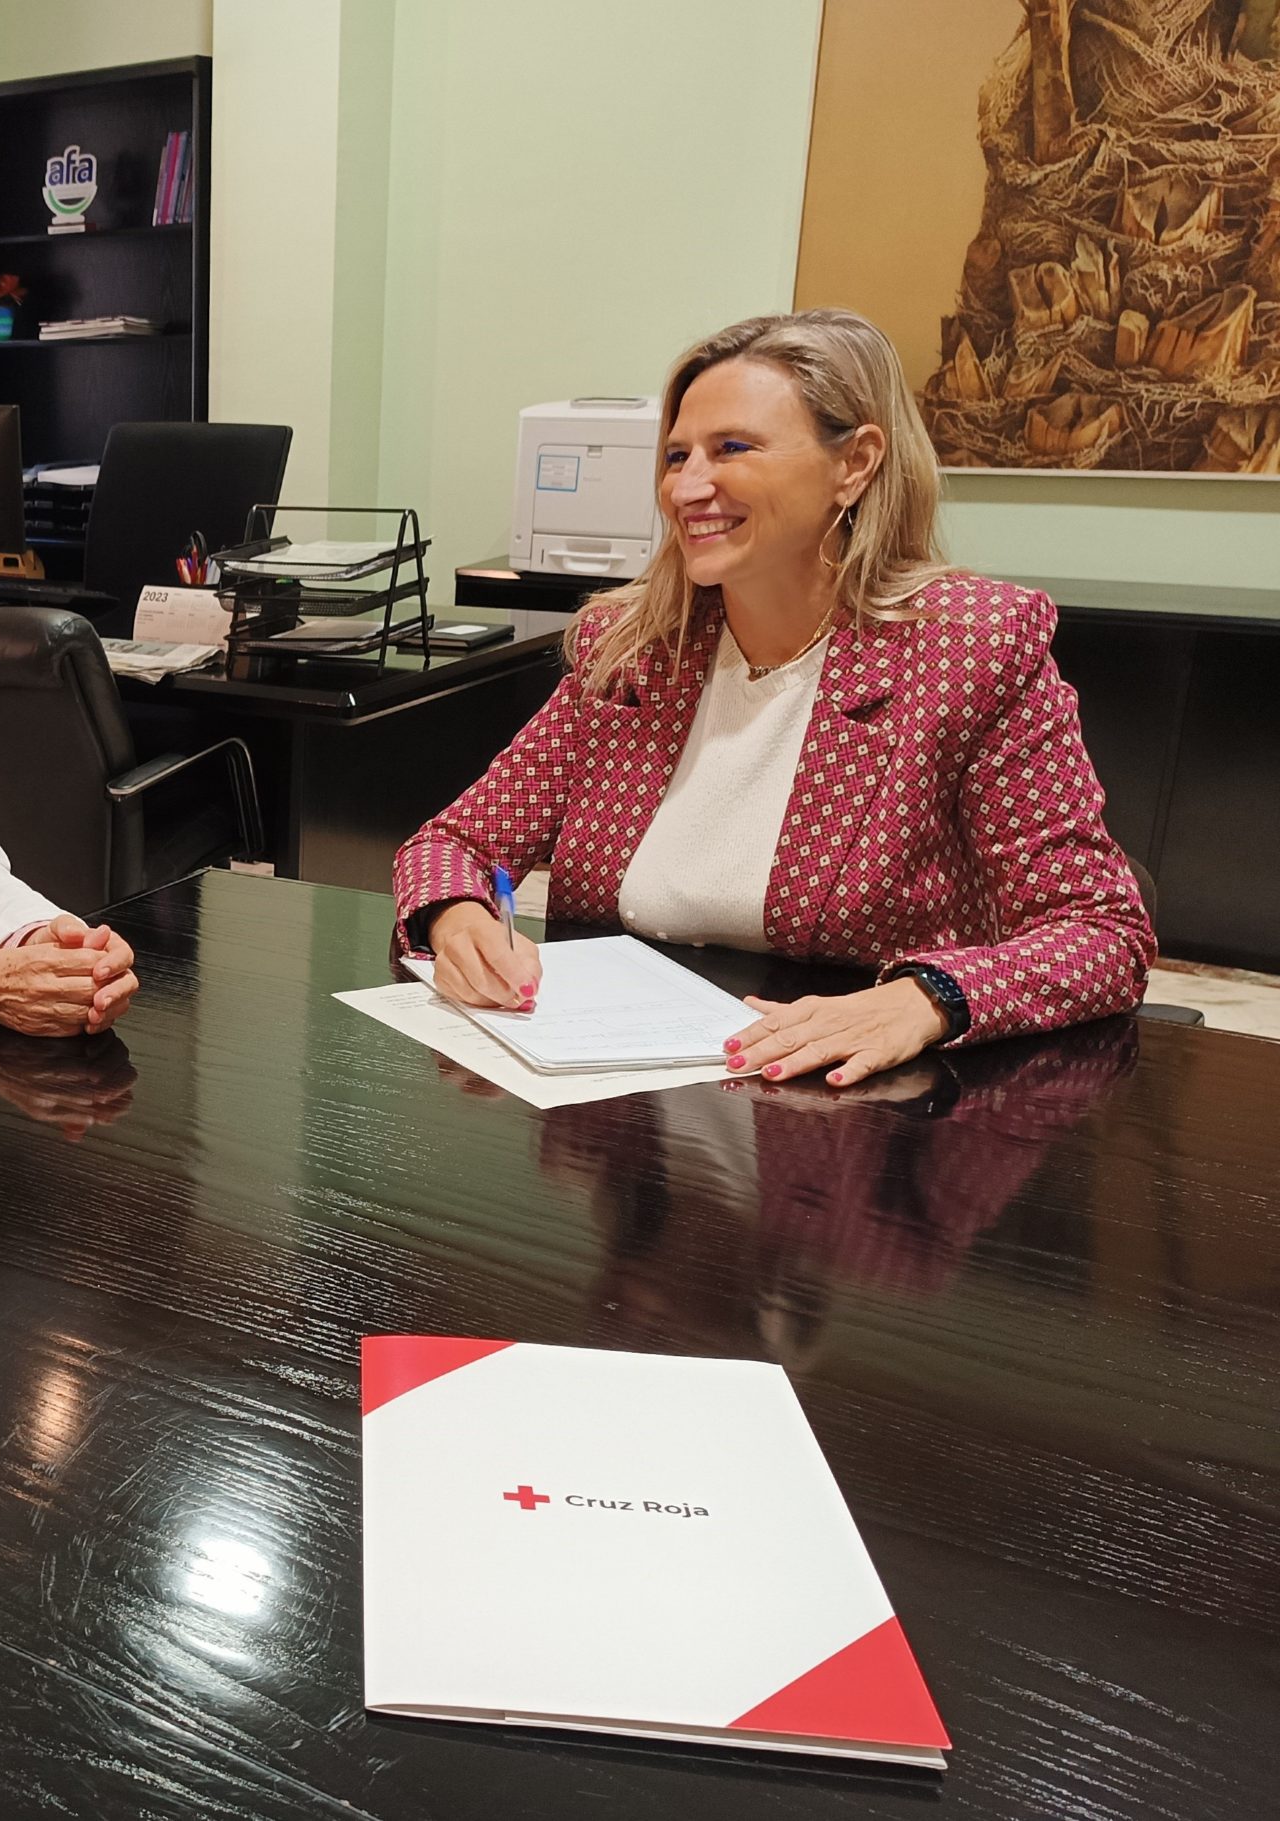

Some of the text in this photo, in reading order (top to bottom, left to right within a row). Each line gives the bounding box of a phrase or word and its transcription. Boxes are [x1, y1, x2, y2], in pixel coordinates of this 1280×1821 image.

[48, 149, 94, 187] afa
[143, 591, 169, 603] 2023
[565, 1494, 709, 1518] Cruz Roja
